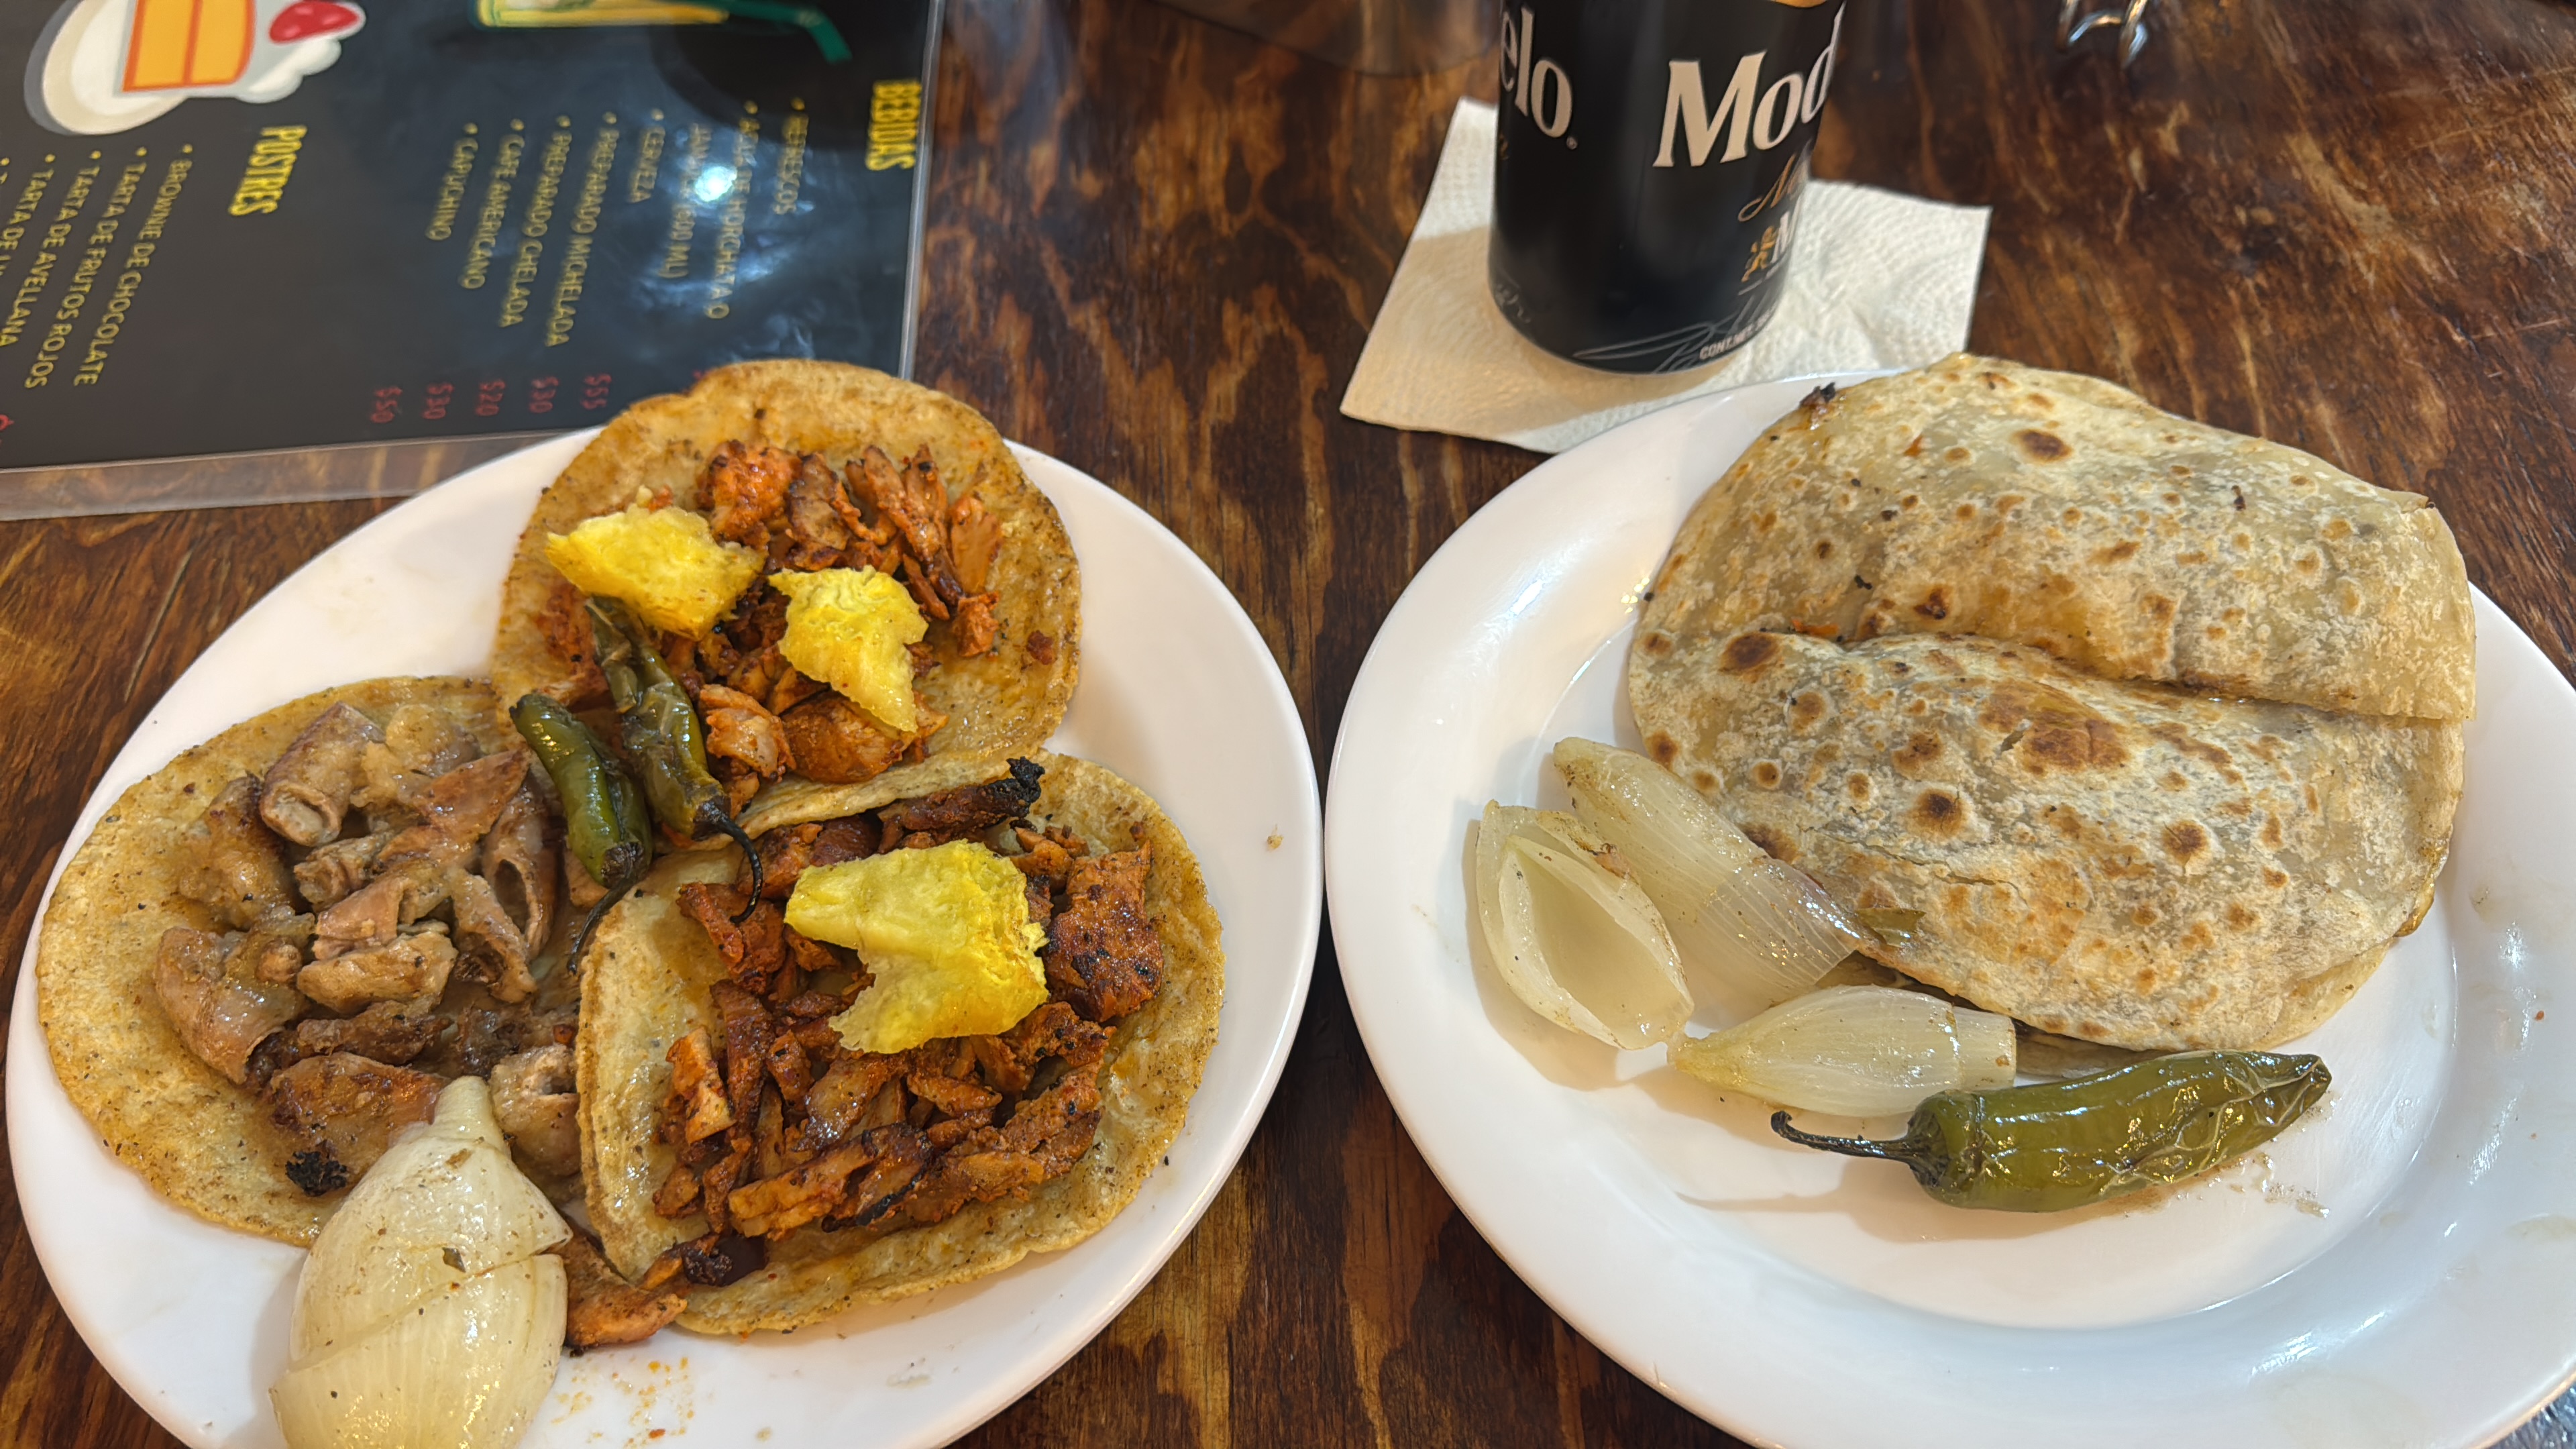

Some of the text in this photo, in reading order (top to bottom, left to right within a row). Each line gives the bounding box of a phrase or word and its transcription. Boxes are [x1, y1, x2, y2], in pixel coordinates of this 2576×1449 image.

[865, 80, 922, 170] BEBIDAS
[1652, 0, 1846, 168] Mod
[0, 168, 54, 250] TARTA DE
[229, 125, 307, 215] POSTRES
[427, 138, 478, 240] CAPUCHINO
[630, 126, 665, 203] CERVEZA
[732, 169, 753, 194] DE
[774, 115, 809, 215] REFRESCOS
[0, 166, 100, 347] TARTA DE AVELLANA
[460, 135, 525, 288] CAFE AMERICANO
[499, 133, 572, 327] PREPARADO CHELADA
[544, 129, 620, 347] PREPARADO MICHELADA
[711, 198, 748, 300] HORCHATA
[25, 162, 147, 388] TARTA DE FRUTOS ROJOS
[74, 160, 193, 386] BROWNIE DE CHOCOLATE
[657, 244, 691, 278] ML)
[705, 303, 730, 319] O
[371, 386, 402, 423] $50
[423, 382, 453, 419] $30
[475, 380, 505, 416] $20
[529, 376, 559, 413] $30
[580, 374, 611, 409] $55
